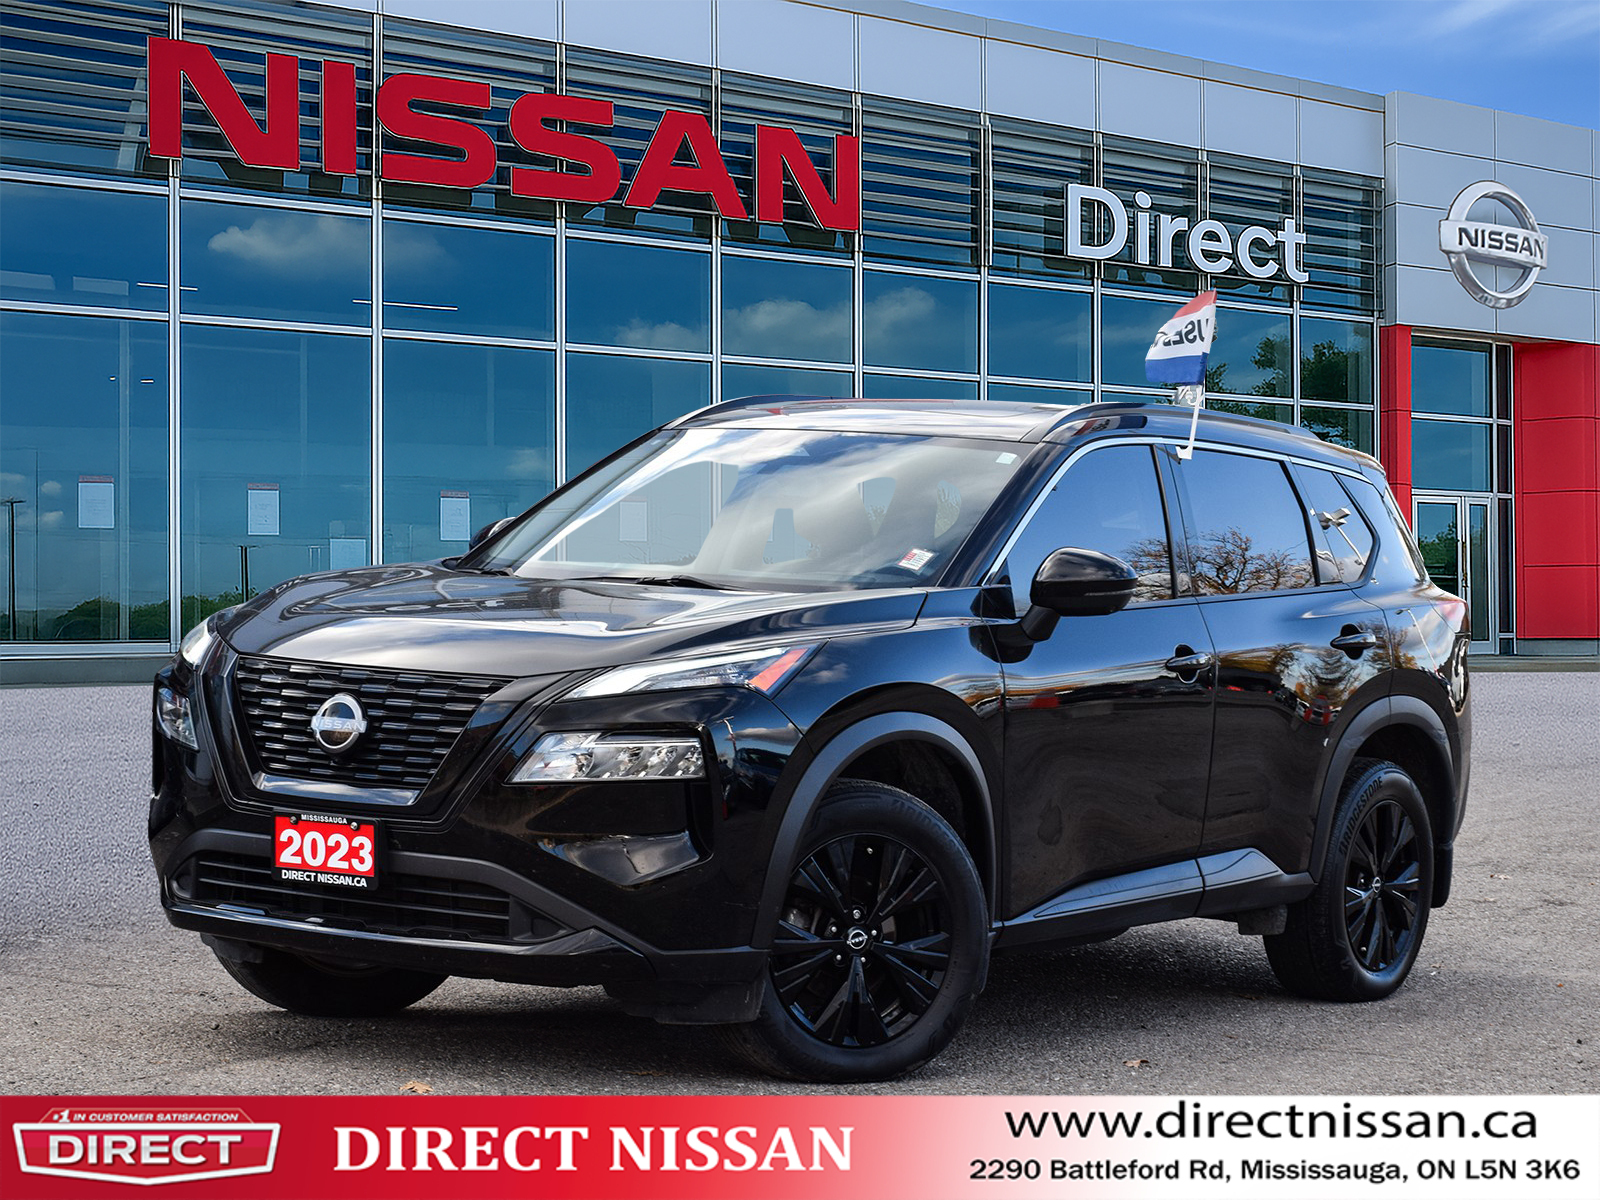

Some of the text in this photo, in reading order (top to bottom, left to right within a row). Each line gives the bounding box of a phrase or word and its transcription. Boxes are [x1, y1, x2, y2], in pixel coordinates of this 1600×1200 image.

[147, 37, 860, 232] NISSAN
[1064, 182, 1310, 284] Direct
[1457, 226, 1545, 260] NISSAN
[312, 717, 365, 733] NISSAN
[301, 813, 348, 825] MISSISSAUGA
[1339, 776, 1383, 855] BRIDGESTONE
[279, 828, 374, 873] 2023
[281, 869, 368, 888] DIRECT NISSAN.CA
